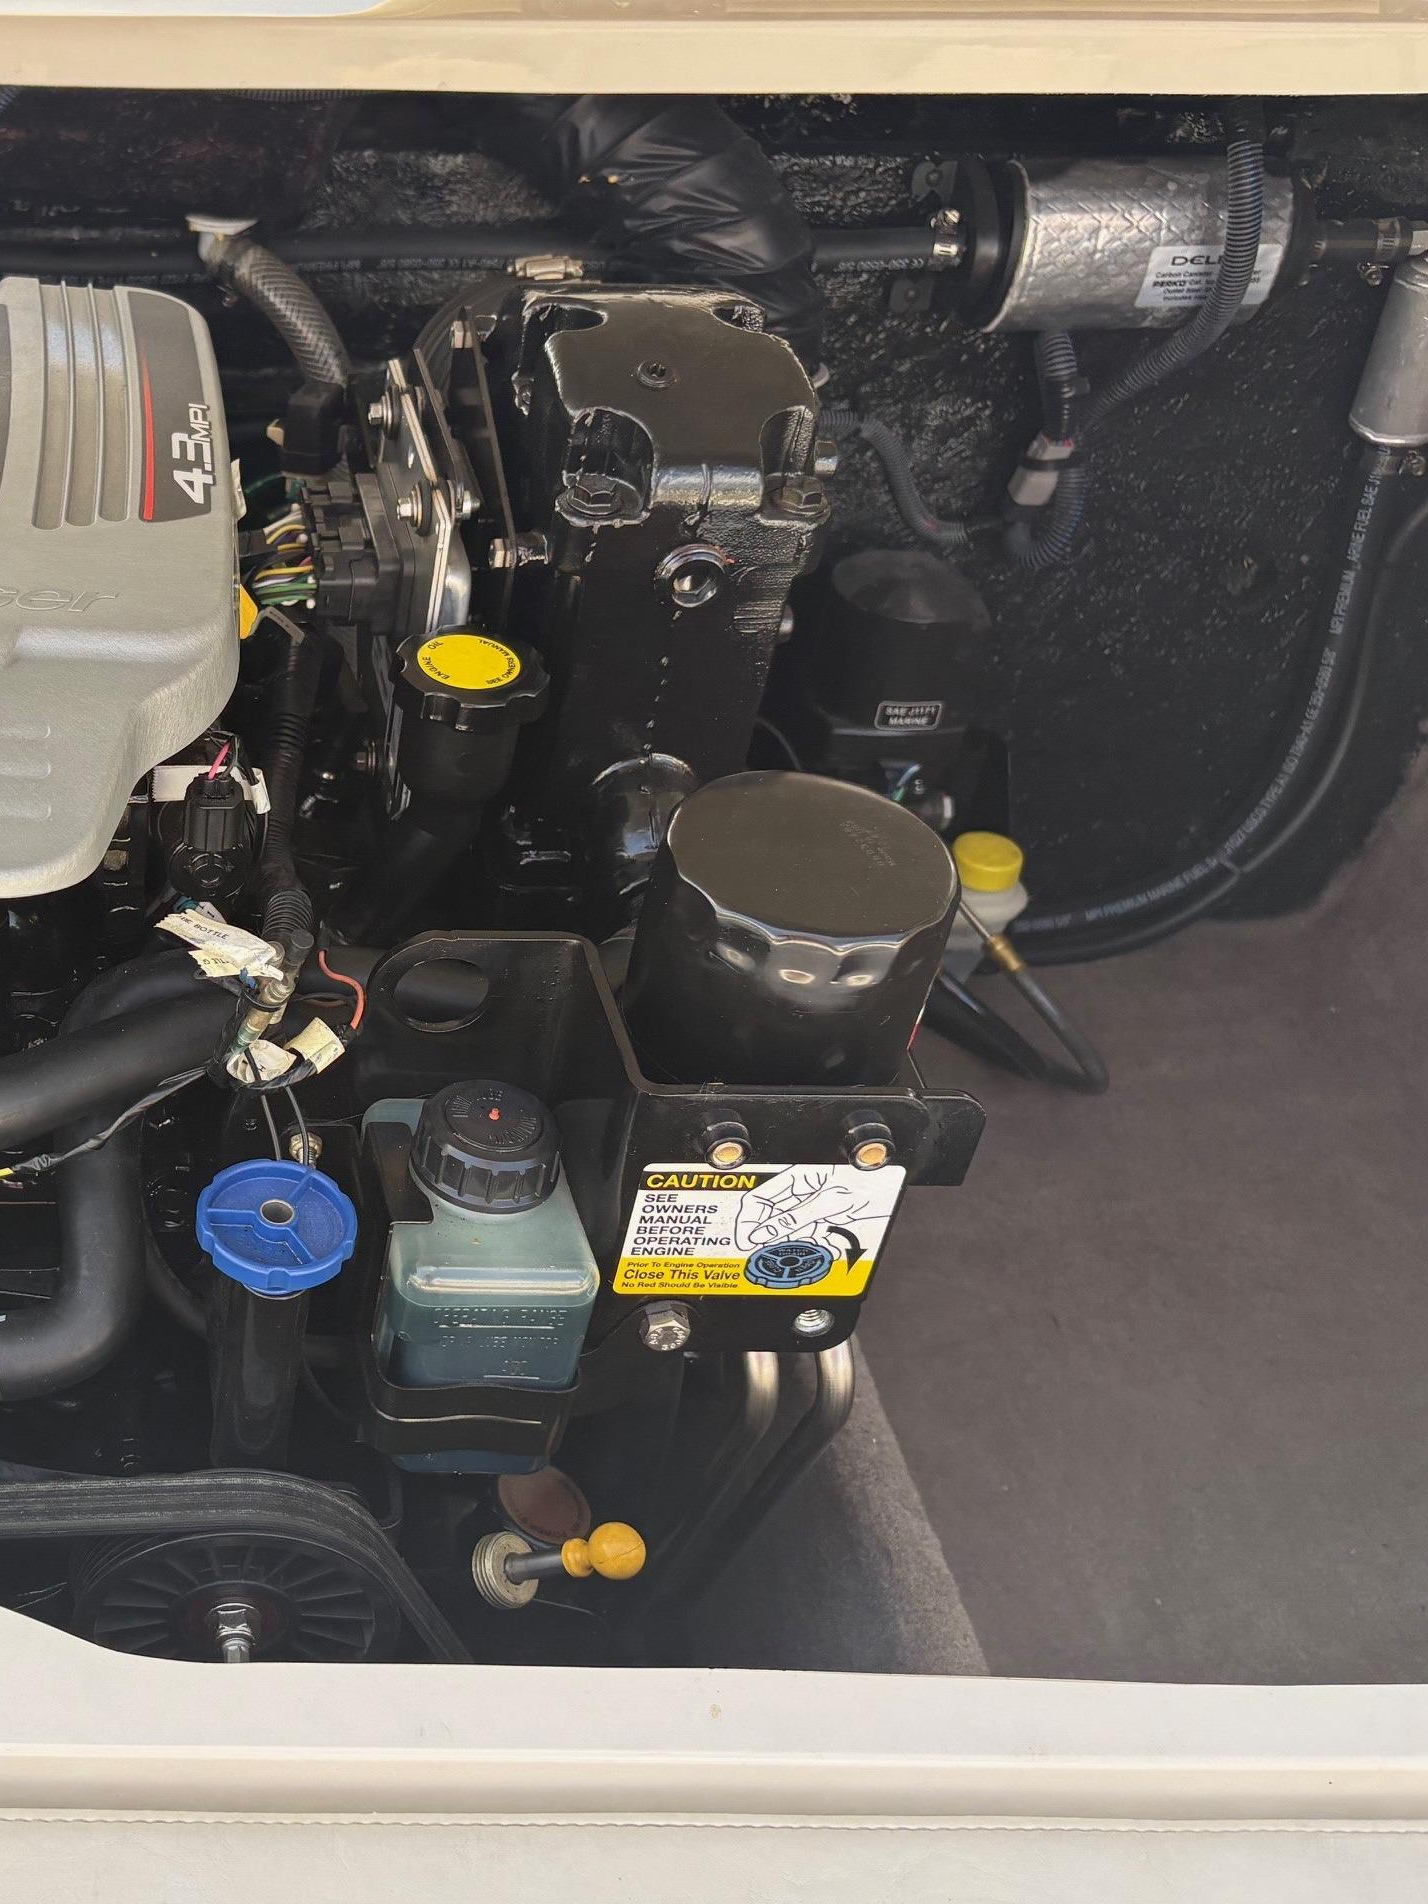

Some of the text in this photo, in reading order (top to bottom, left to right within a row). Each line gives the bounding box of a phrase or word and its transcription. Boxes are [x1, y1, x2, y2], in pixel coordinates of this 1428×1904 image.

[1172, 255, 1223, 266] DEL
[478, 639, 510, 657] MANUAL
[422, 640, 451, 680] ENGINE OIL
[502, 657, 516, 678] OWNERS
[889, 716, 928, 726] MARINE
[193, 921, 229, 940] BOTTLE
[646, 1174, 756, 1189] CAUTION
[644, 1193, 678, 1203] SEE
[642, 1205, 718, 1214] OWNERS
[638, 1215, 712, 1225] MANUAL
[636, 1226, 705, 1235] BEFORE
[633, 1236, 731, 1246] OPERATING
[630, 1247, 695, 1256] ENGINE
[663, 1262, 694, 1270] Engine
[696, 1262, 740, 1270] Operation
[624, 1269, 741, 1280] Close This Valve
